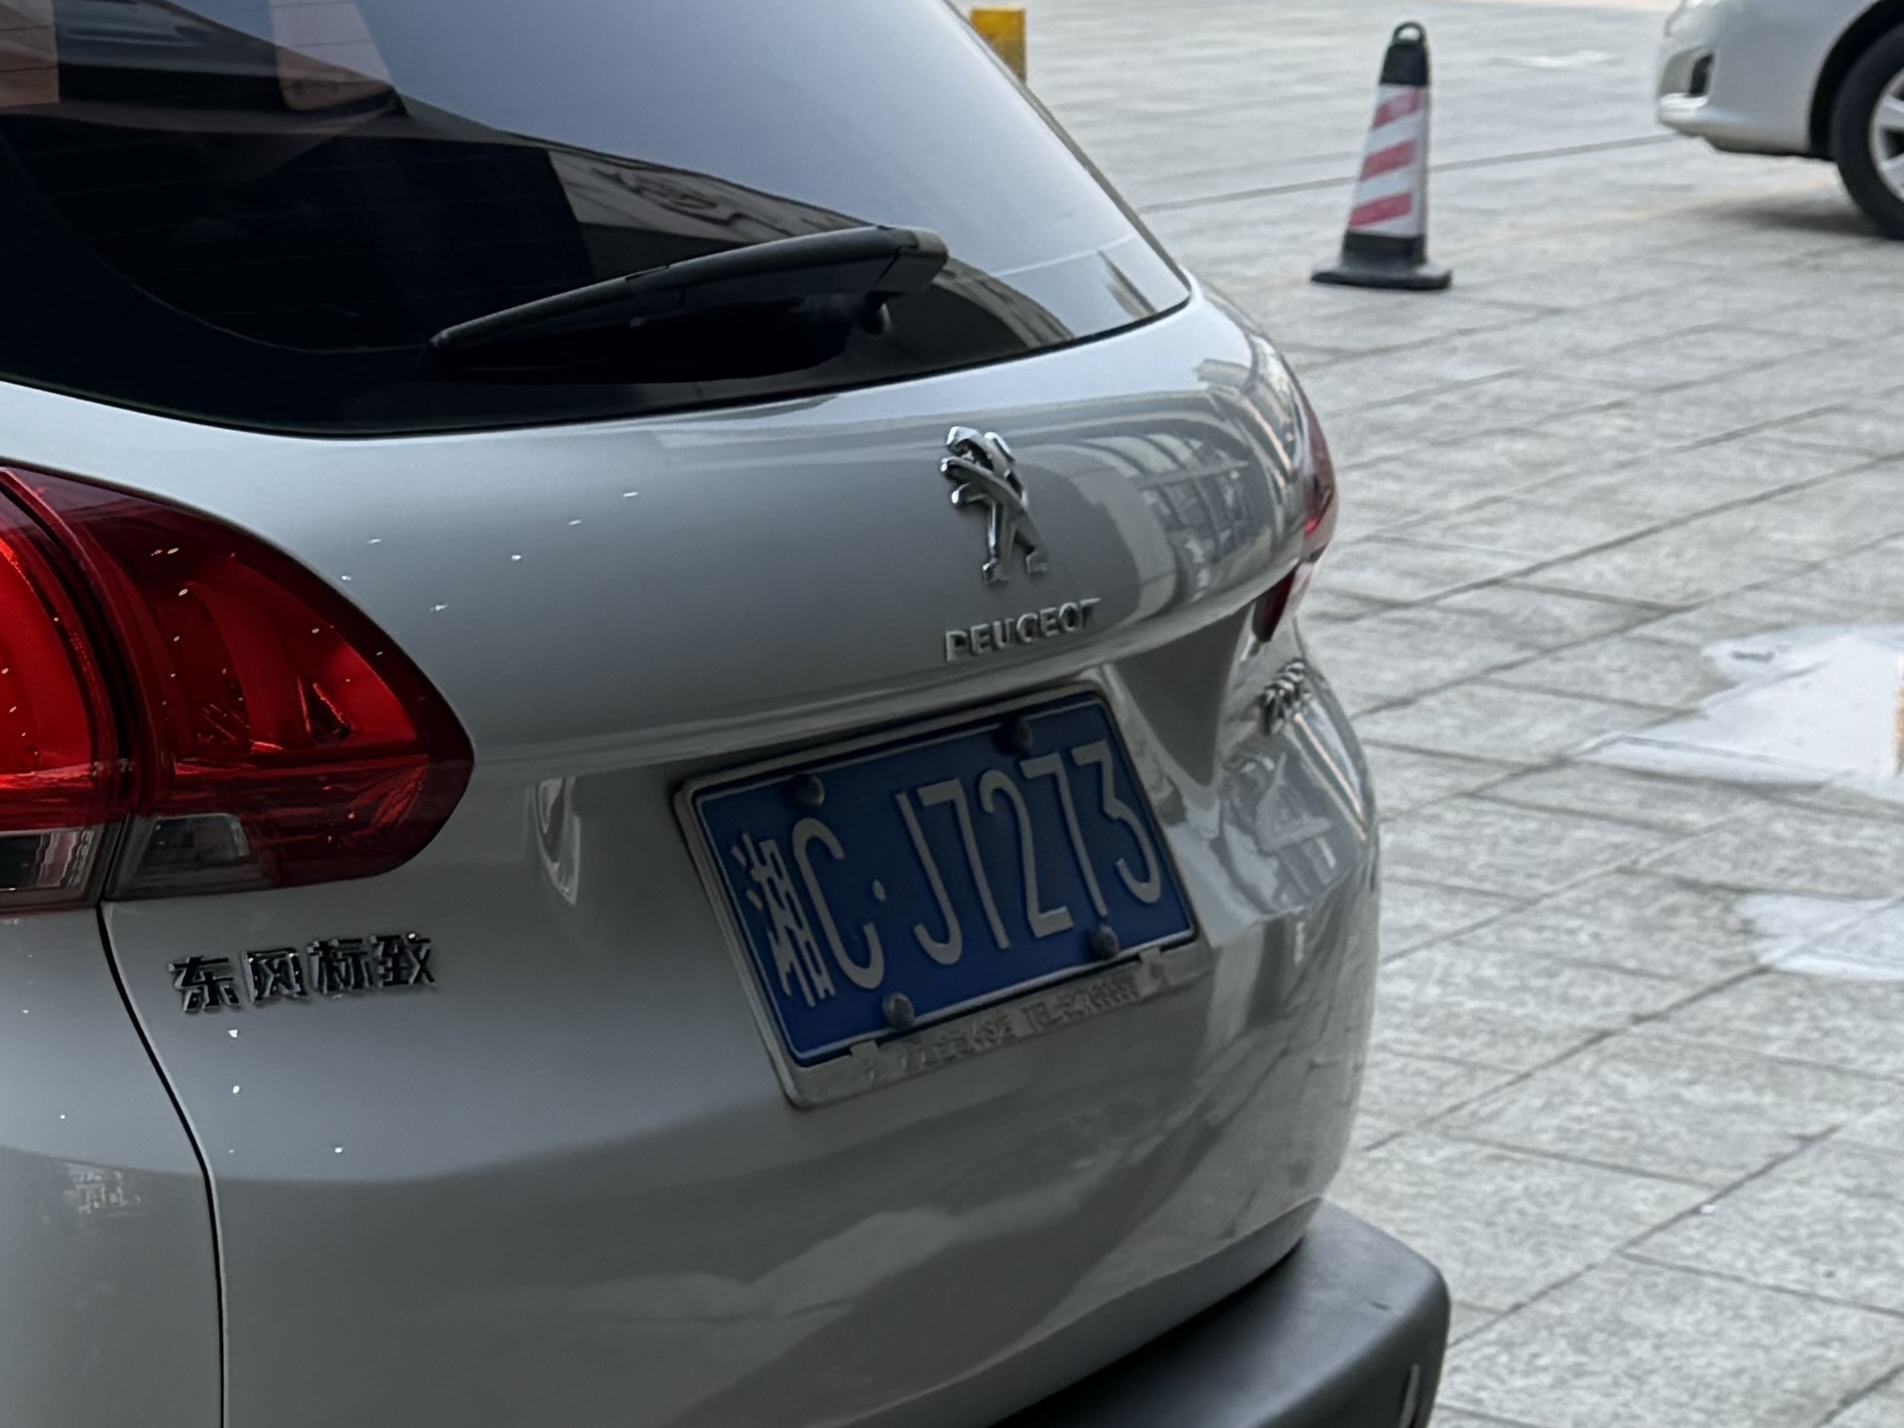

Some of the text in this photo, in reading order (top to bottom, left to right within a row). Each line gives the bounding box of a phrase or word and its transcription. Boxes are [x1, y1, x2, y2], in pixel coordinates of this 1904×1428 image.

[944, 597, 1101, 663] PEUGEOT
[167, 933, 436, 1014] 东风标致
